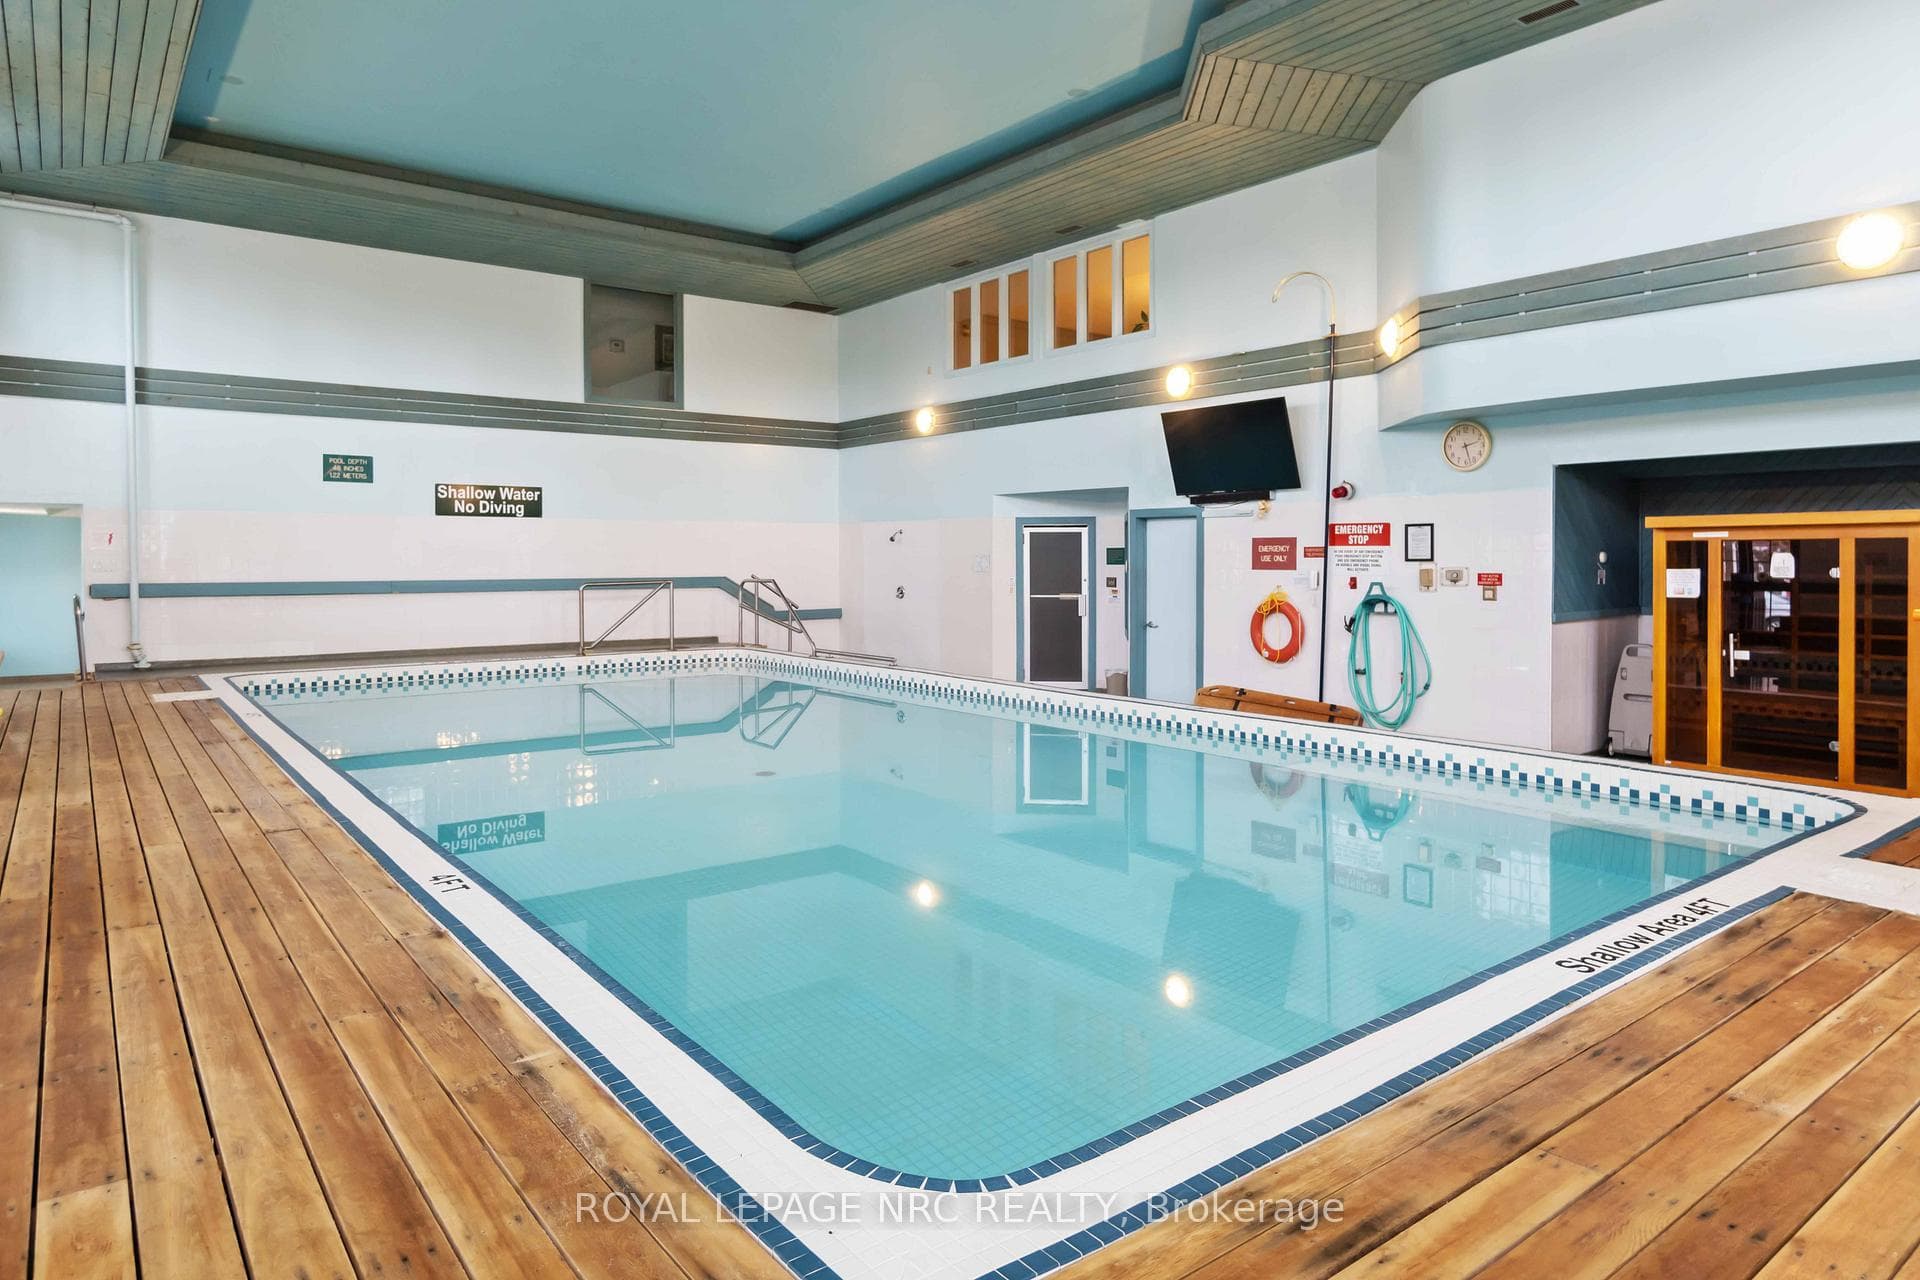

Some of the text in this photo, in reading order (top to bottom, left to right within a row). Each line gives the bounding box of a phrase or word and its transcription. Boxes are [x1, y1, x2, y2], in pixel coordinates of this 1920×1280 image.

[328, 457, 345, 465] POOL
[342, 472, 367, 480] METERS
[437, 484, 541, 502] Shallow Water
[454, 499, 525, 517] No Diving
[1334, 525, 1384, 534] EMERGENCY
[1348, 535, 1369, 544] STOP
[1258, 545, 1290, 553] EMERGENCY
[429, 874, 471, 893] 4FT
[1555, 897, 1730, 974] Shallow Area 4FT
